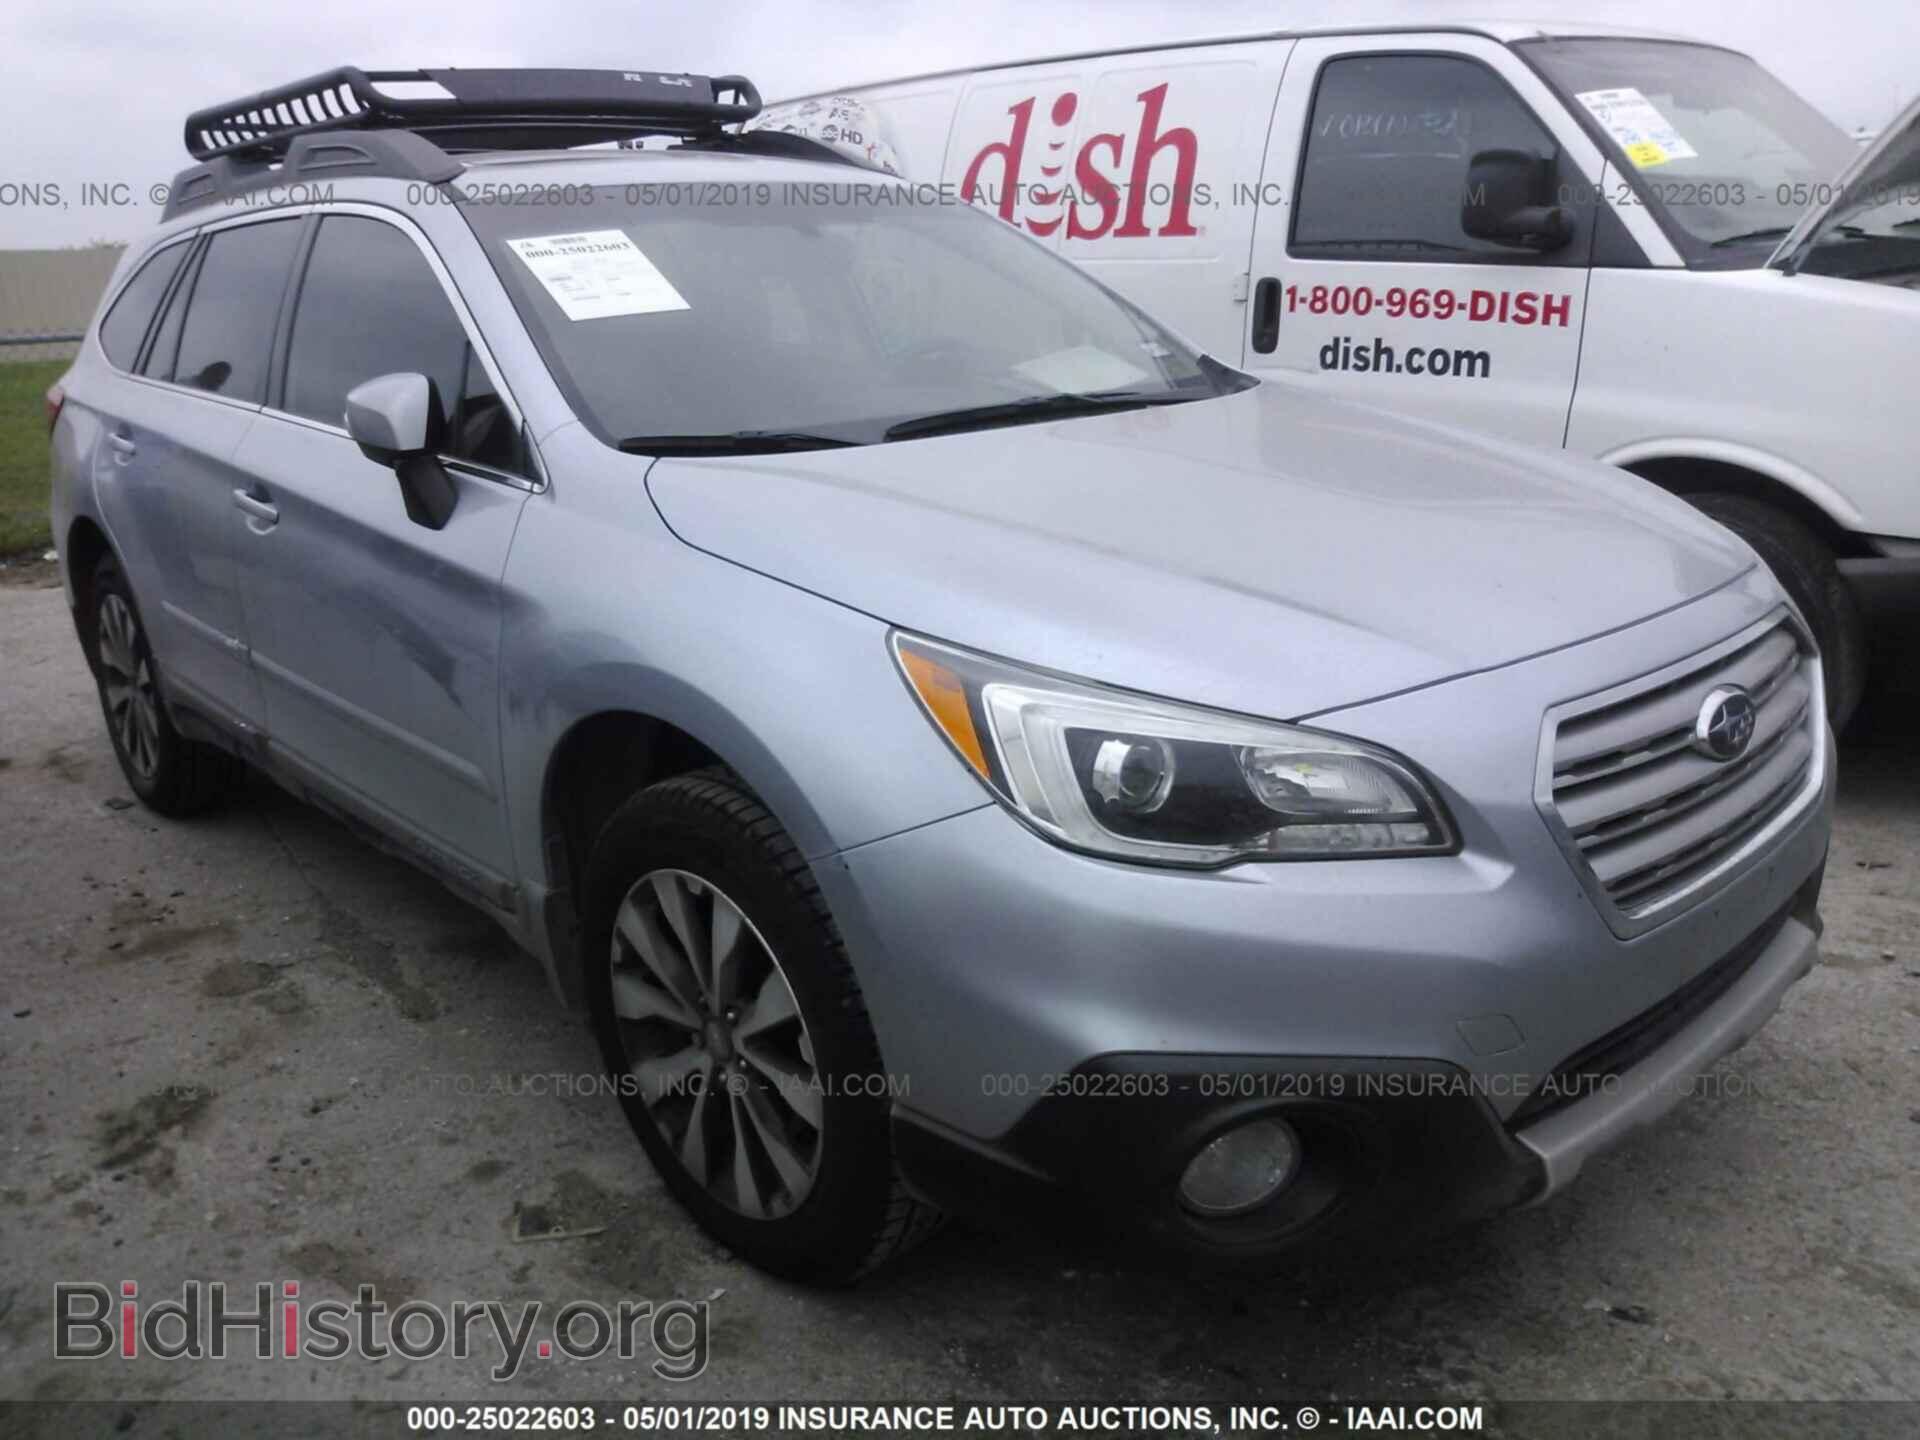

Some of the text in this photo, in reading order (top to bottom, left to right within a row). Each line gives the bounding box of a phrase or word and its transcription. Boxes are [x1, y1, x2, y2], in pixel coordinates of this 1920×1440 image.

[841, 128, 864, 145] HD
[961, 82, 1198, 240] dish
[1286, 285, 1571, 327] 1-800-969-DISH
[1319, 336, 1490, 378] dish.com
